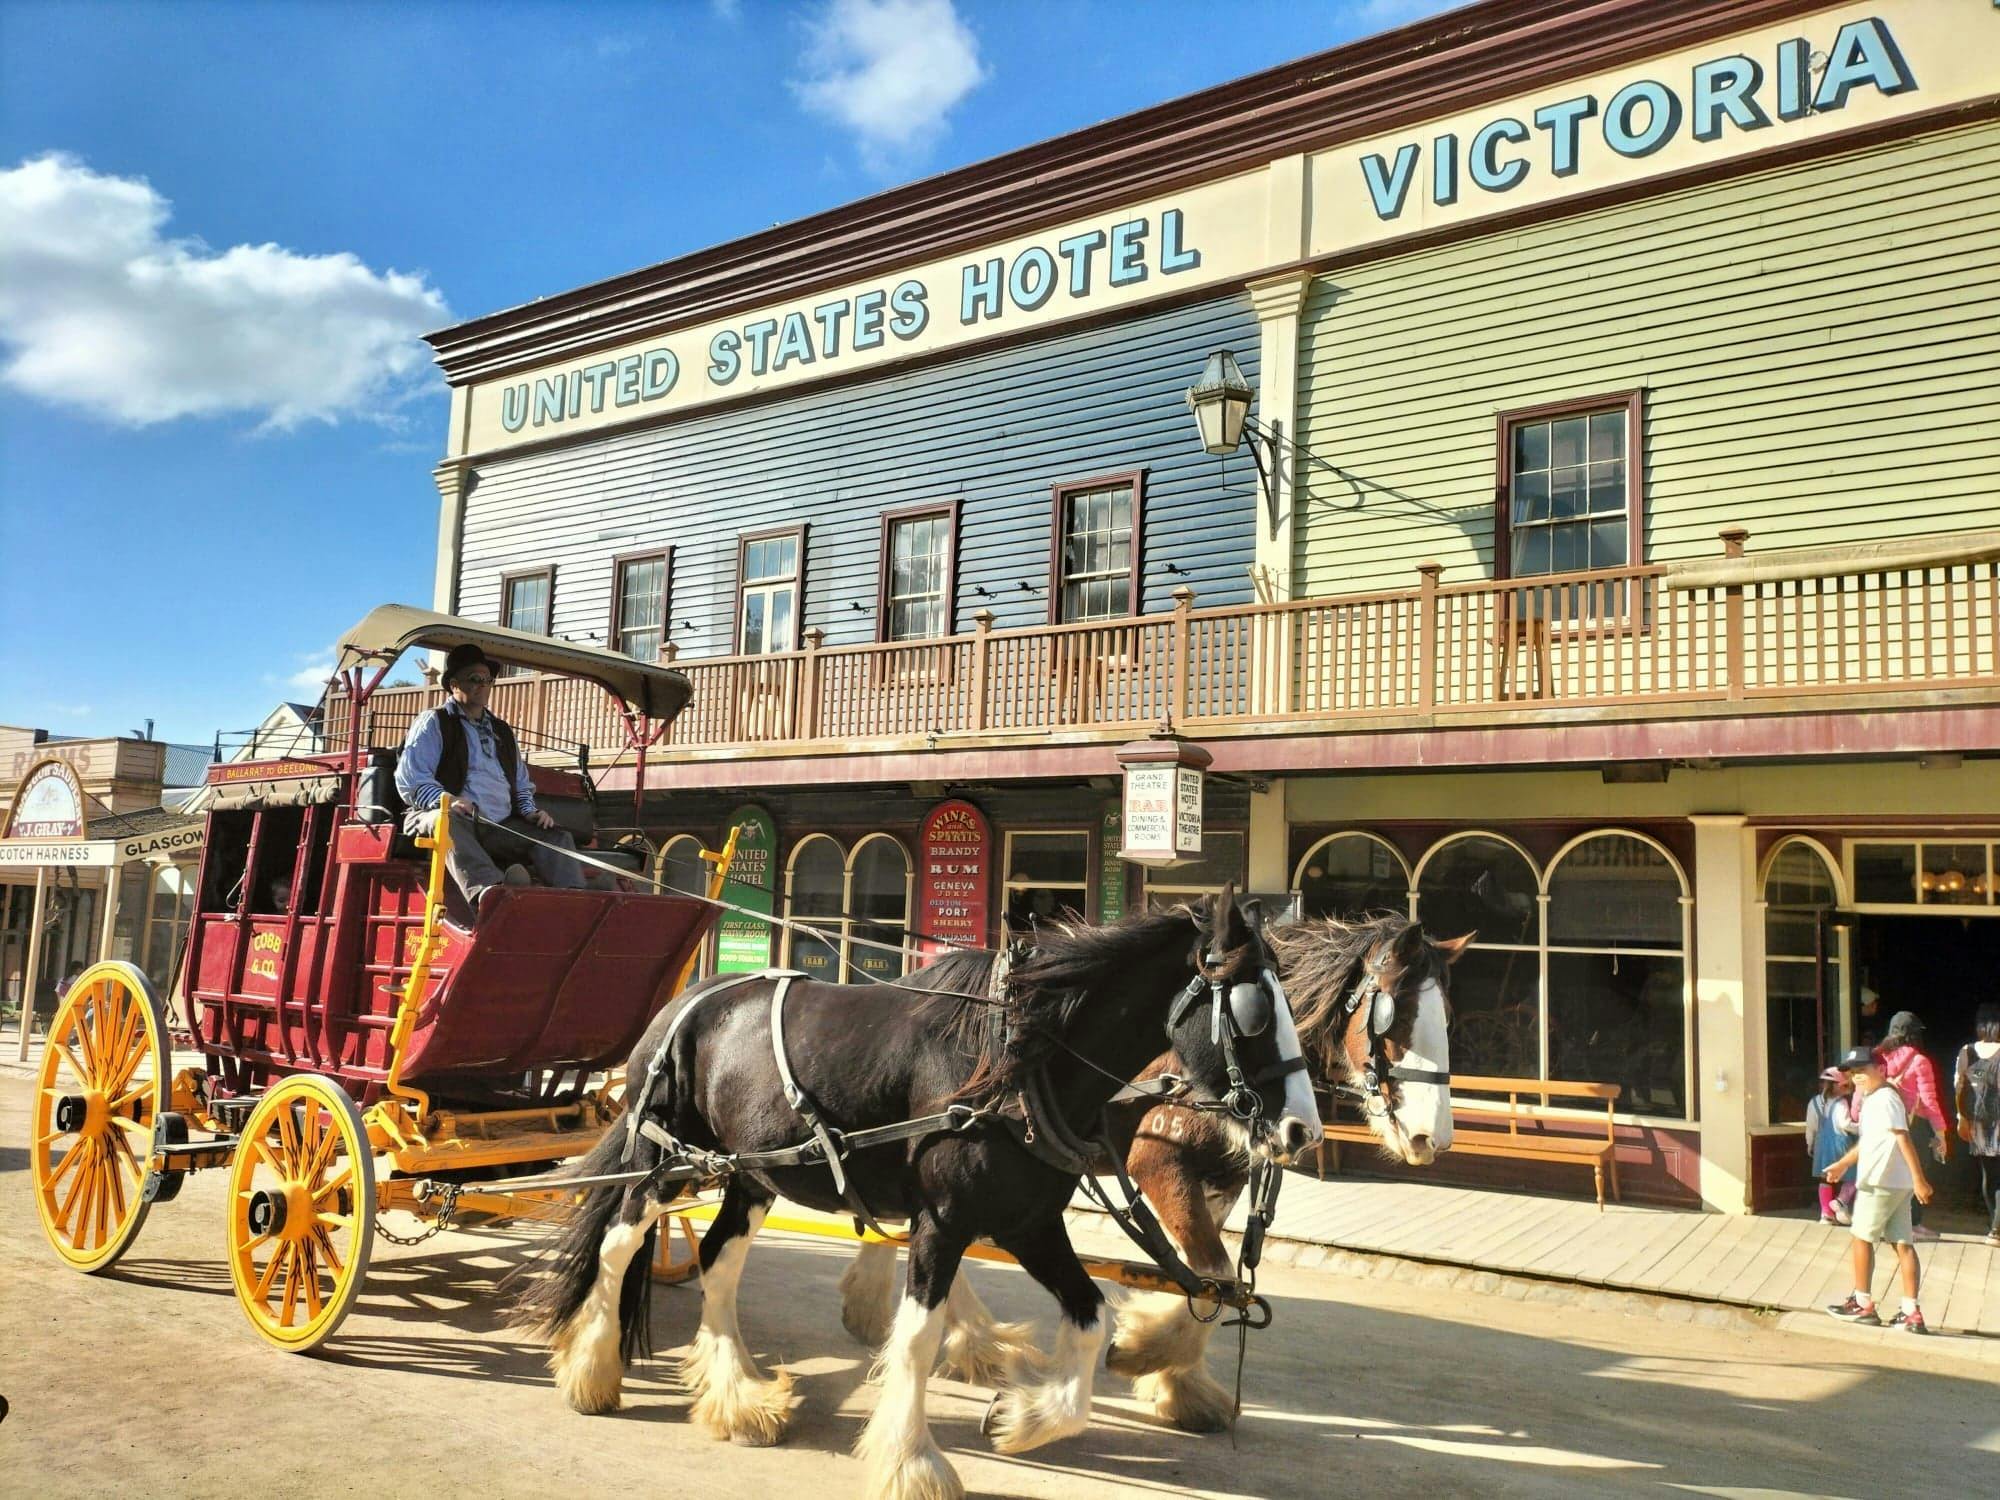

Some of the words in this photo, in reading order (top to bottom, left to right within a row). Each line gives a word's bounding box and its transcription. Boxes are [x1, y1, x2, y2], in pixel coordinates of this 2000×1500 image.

[1360, 16, 1918, 220] VICTORIA
[501, 346, 680, 433] UNITED
[707, 279, 929, 386] STATES
[960, 208, 1201, 325] HOTEL
[226, 767, 263, 779] BALLARAT
[277, 763, 318, 776] GEELONG
[1135, 773, 1165, 781] GRAND
[1180, 772, 1200, 784] UNITED
[1130, 782, 1169, 790] THEATRE
[1180, 783, 1199, 795] STATES
[1181, 794, 1197, 806] HOTEL
[933, 810, 977, 830] WINES
[1131, 815, 1159, 823] DINING
[1179, 811, 1201, 824] VICTORIA
[1128, 824, 1169, 832] COMMERCIAL
[1178, 823, 1200, 835] THEATRE
[928, 831, 981, 842] SPIRITS
[1134, 833, 1160, 841] ROOMS
[36, 847, 90, 861] HARNESS
[733, 848, 768, 860] NITED
[930, 846, 980, 856] BRANDY
[729, 861, 766, 872] STATES
[929, 864, 980, 875] RUM
[729, 873, 764, 885] HOTEL
[933, 881, 976, 890] GENEVA
[938, 907, 969, 916] PORT
[722, 921, 743, 929] FIRST
[744, 921, 766, 930] CLASS
[933, 919, 974, 927] SHERRY
[744, 929, 768, 938] ROOM
[254, 932, 281, 953] COBB
[806, 956, 824, 965] BAR
[866, 960, 885, 968] BAR
[251, 959, 260, 975] &
